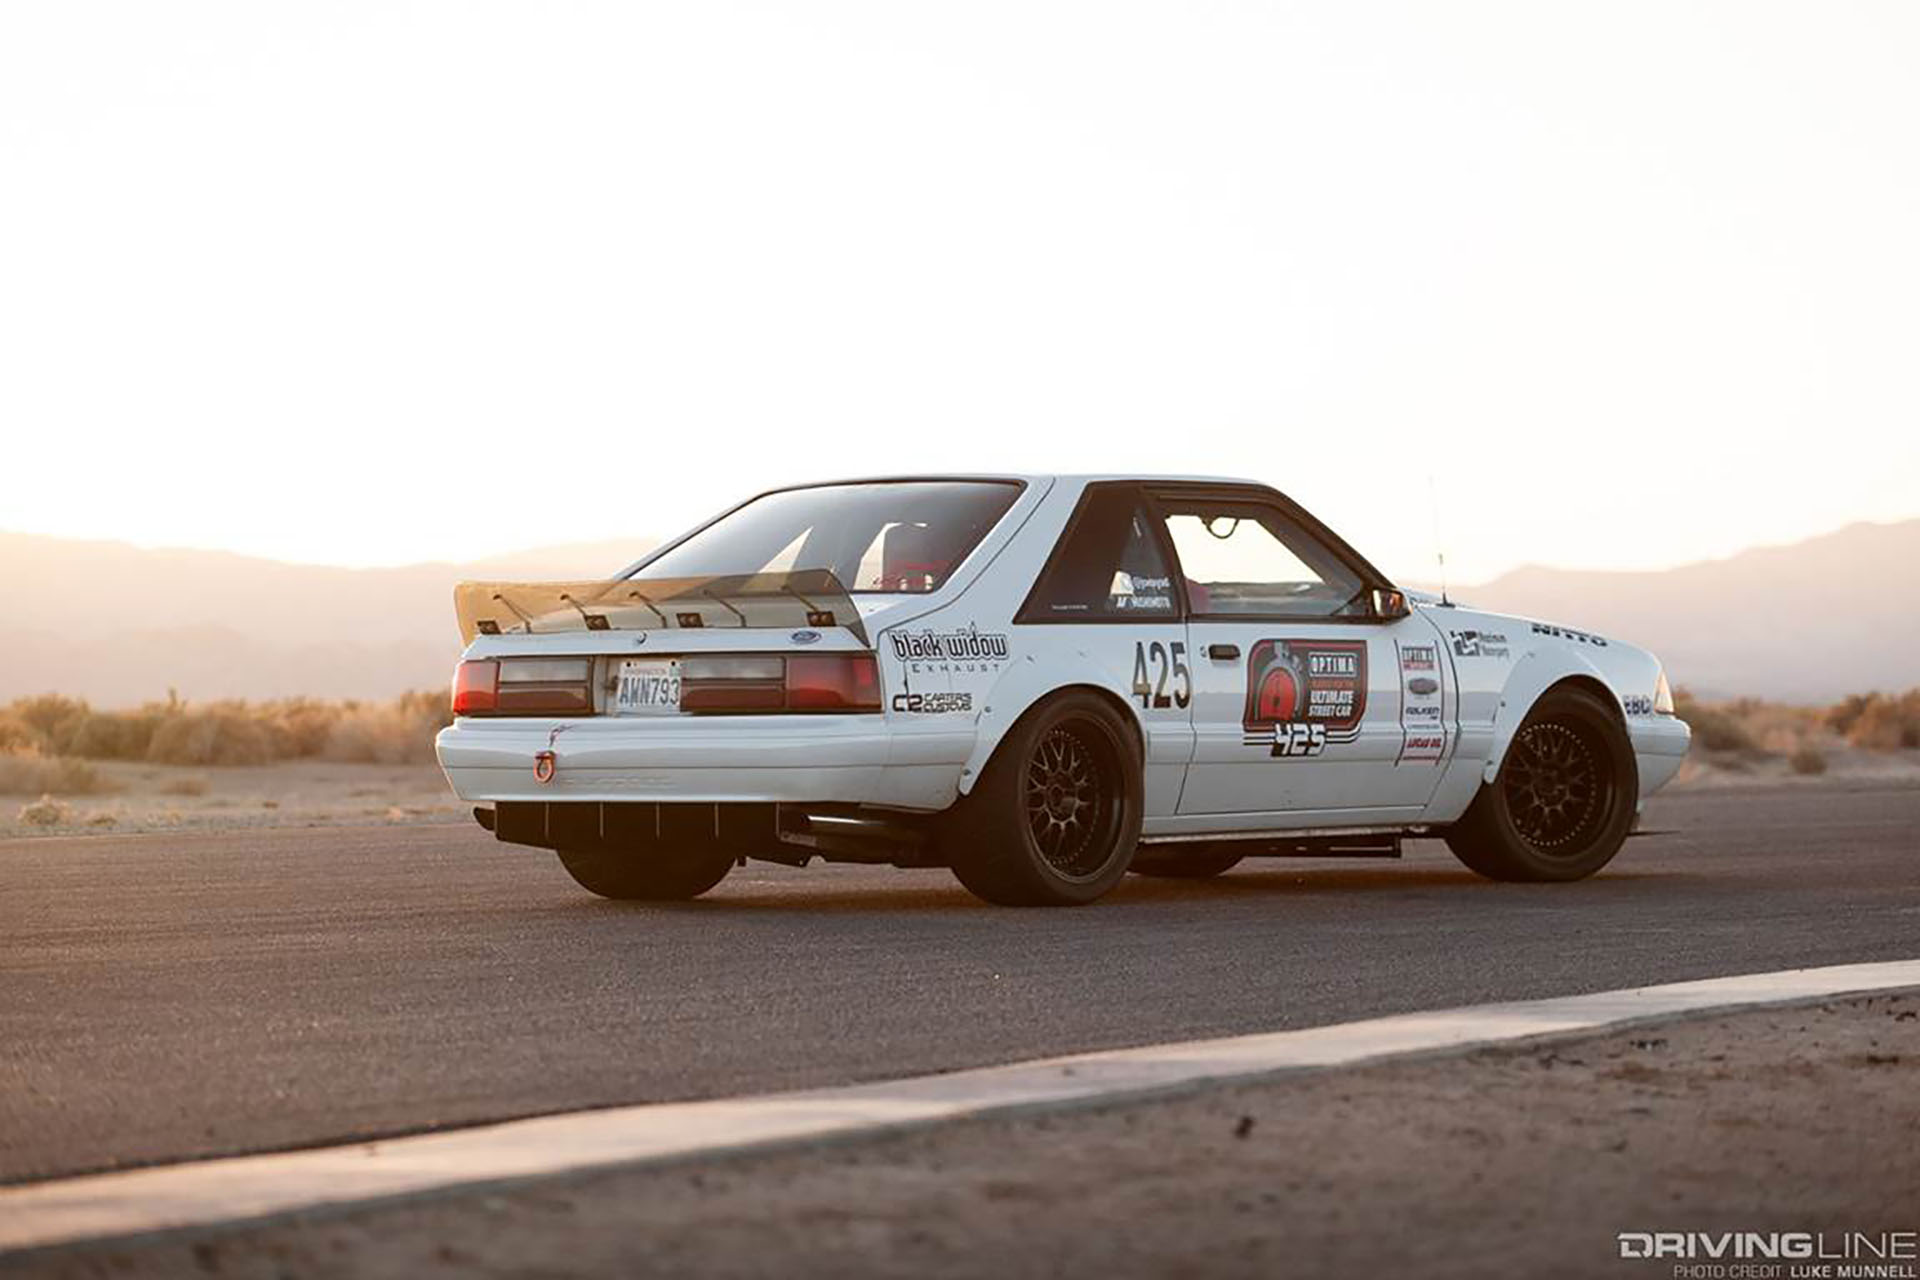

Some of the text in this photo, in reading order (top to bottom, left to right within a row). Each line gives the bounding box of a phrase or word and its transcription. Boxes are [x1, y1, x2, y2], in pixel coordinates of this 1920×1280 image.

[891, 630, 1008, 658] black widow
[1532, 623, 1608, 647] NITTO
[911, 663, 1000, 673] EXHAUST
[1311, 656, 1355, 673] OPTIMA
[1132, 641, 1190, 709] 425
[1310, 690, 1354, 704] ULTIMATE
[1623, 694, 1651, 715] EBC
[1308, 705, 1353, 718] STREET CAR
[1272, 723, 1326, 757] 425
[1407, 737, 1431, 748] LUCAS
